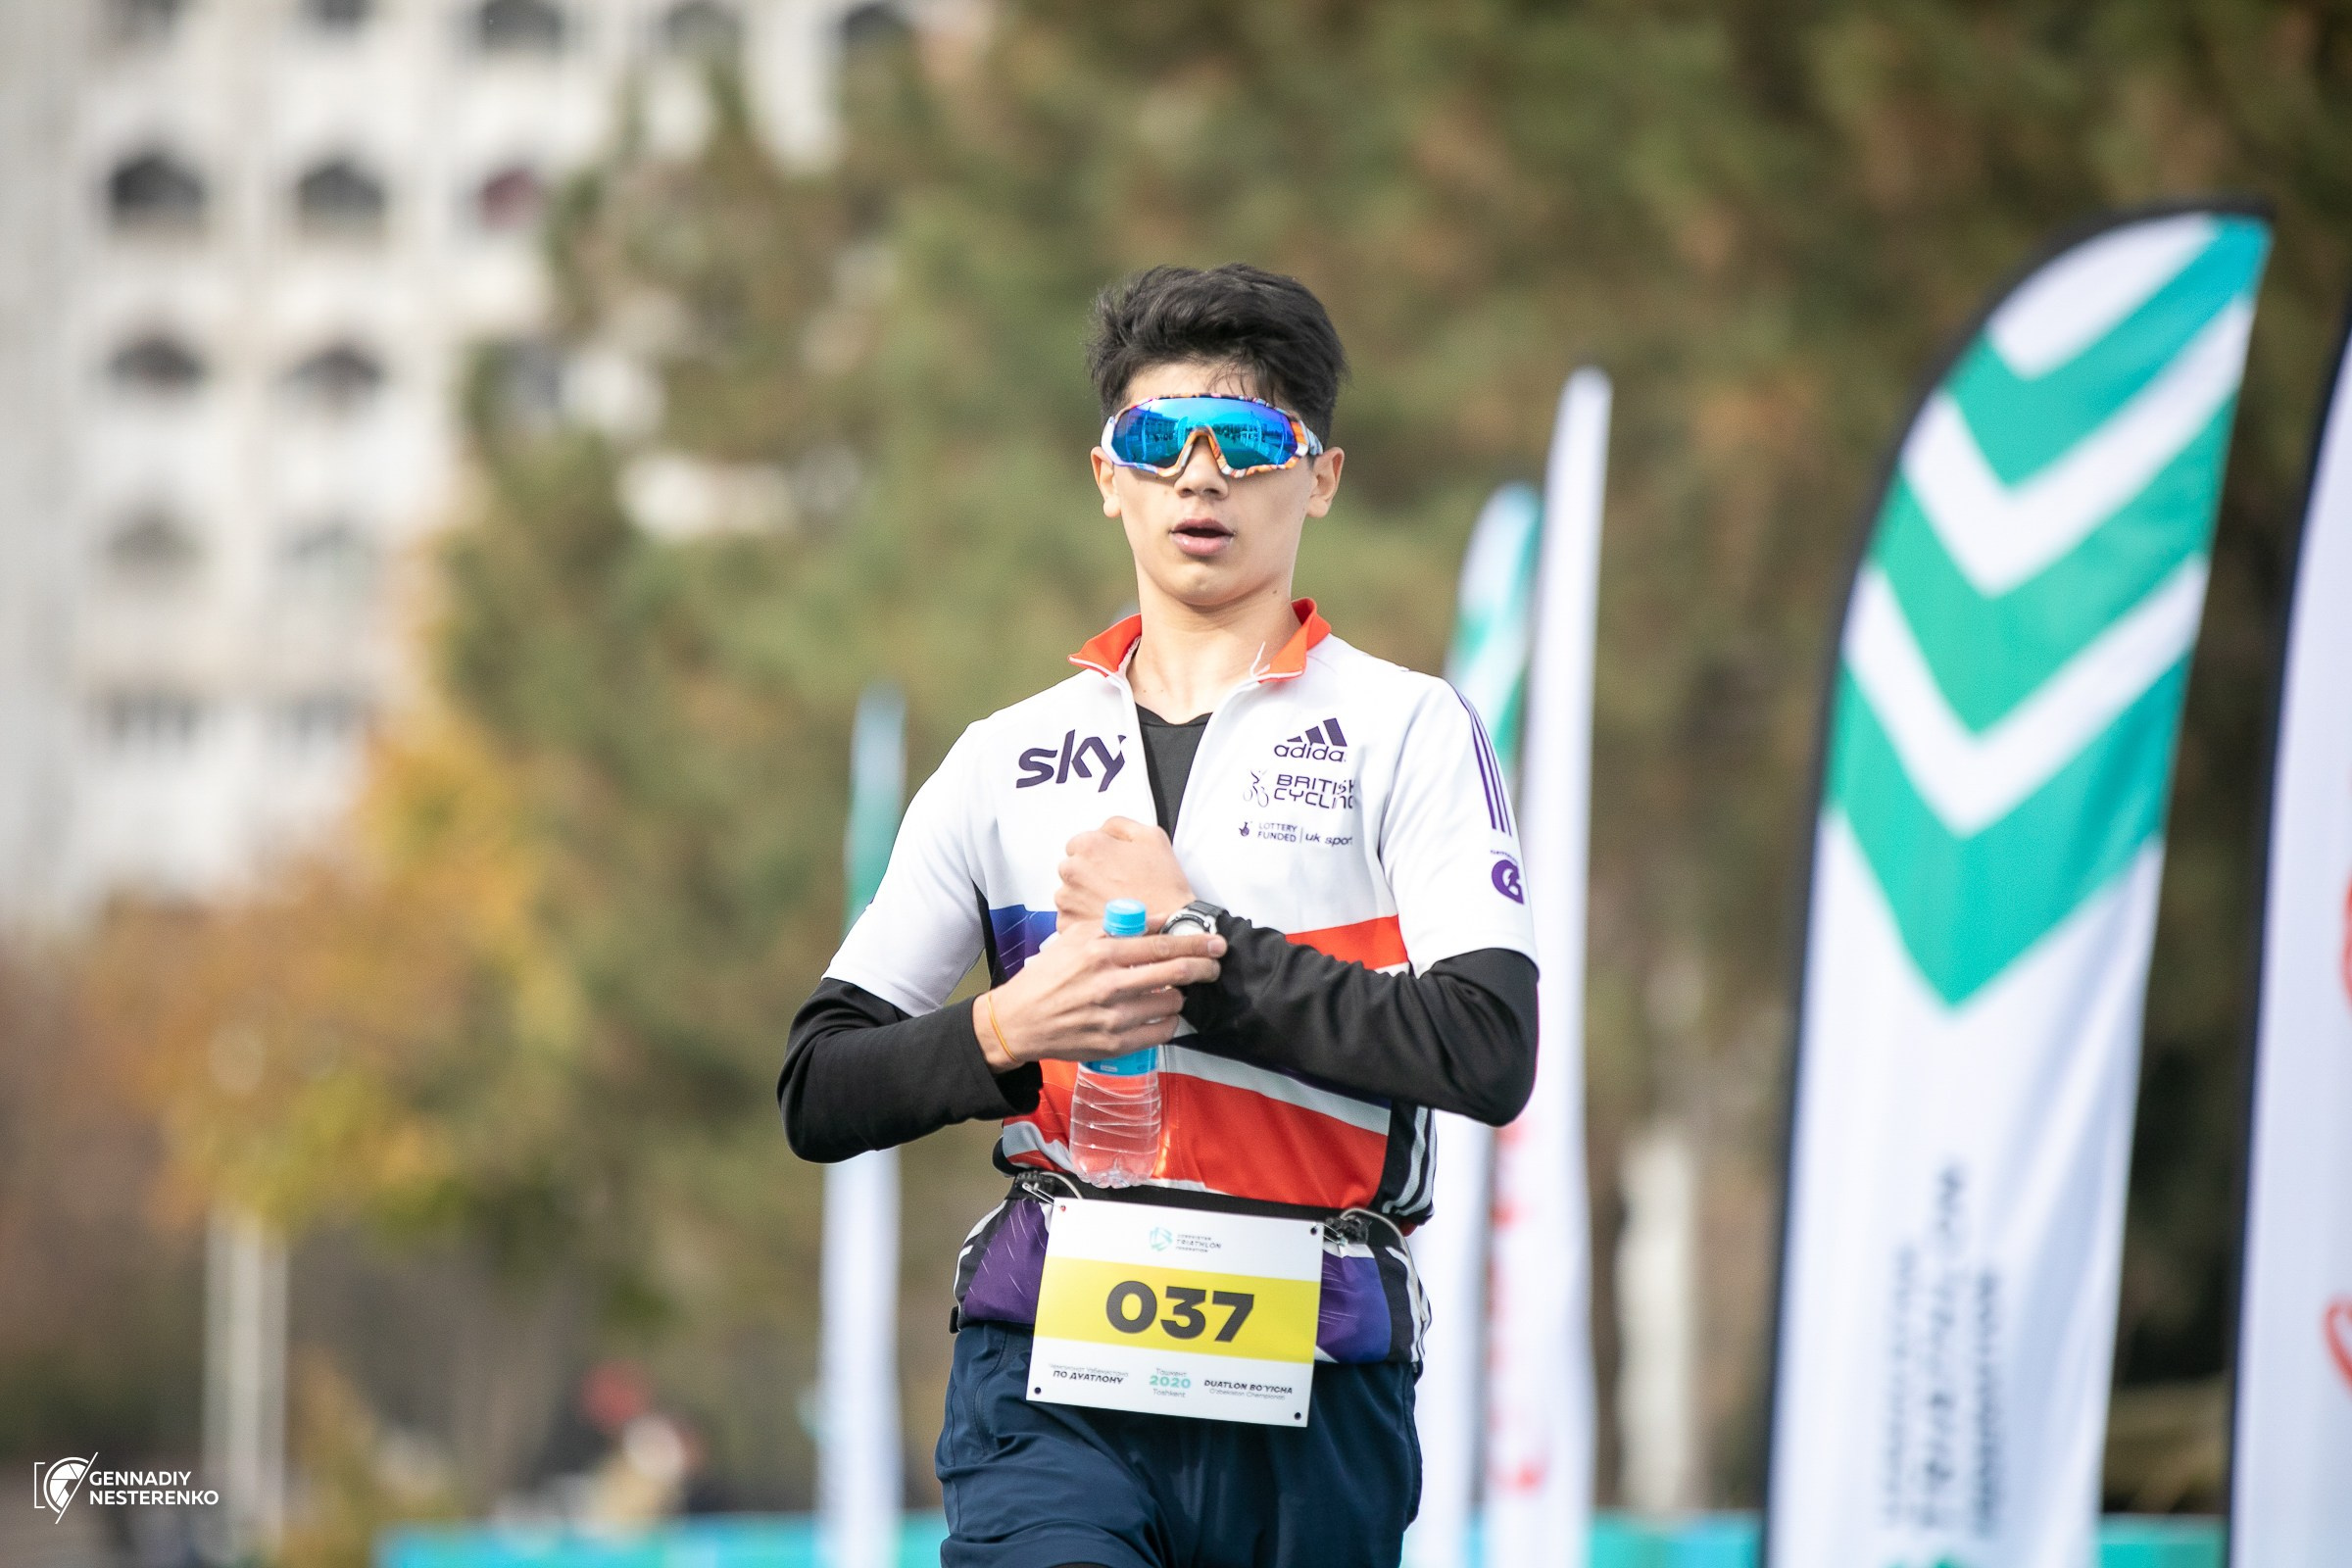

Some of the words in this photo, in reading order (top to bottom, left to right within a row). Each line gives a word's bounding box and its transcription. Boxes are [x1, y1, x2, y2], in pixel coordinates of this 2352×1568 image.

[1274, 744, 1347, 762] adida
[1016, 729, 1126, 792] sky
[1258, 823, 1298, 833] LOTTERY
[1257, 831, 1297, 843] FUNDED
[1305, 833, 1321, 843] uk
[1325, 836, 1353, 847] spor
[1105, 1280, 1255, 1343] 037
[1069, 1372, 1124, 1385] ДУАТЛОНУ
[1150, 1375, 1192, 1389] 2020
[1204, 1380, 1248, 1391] DUATLON
